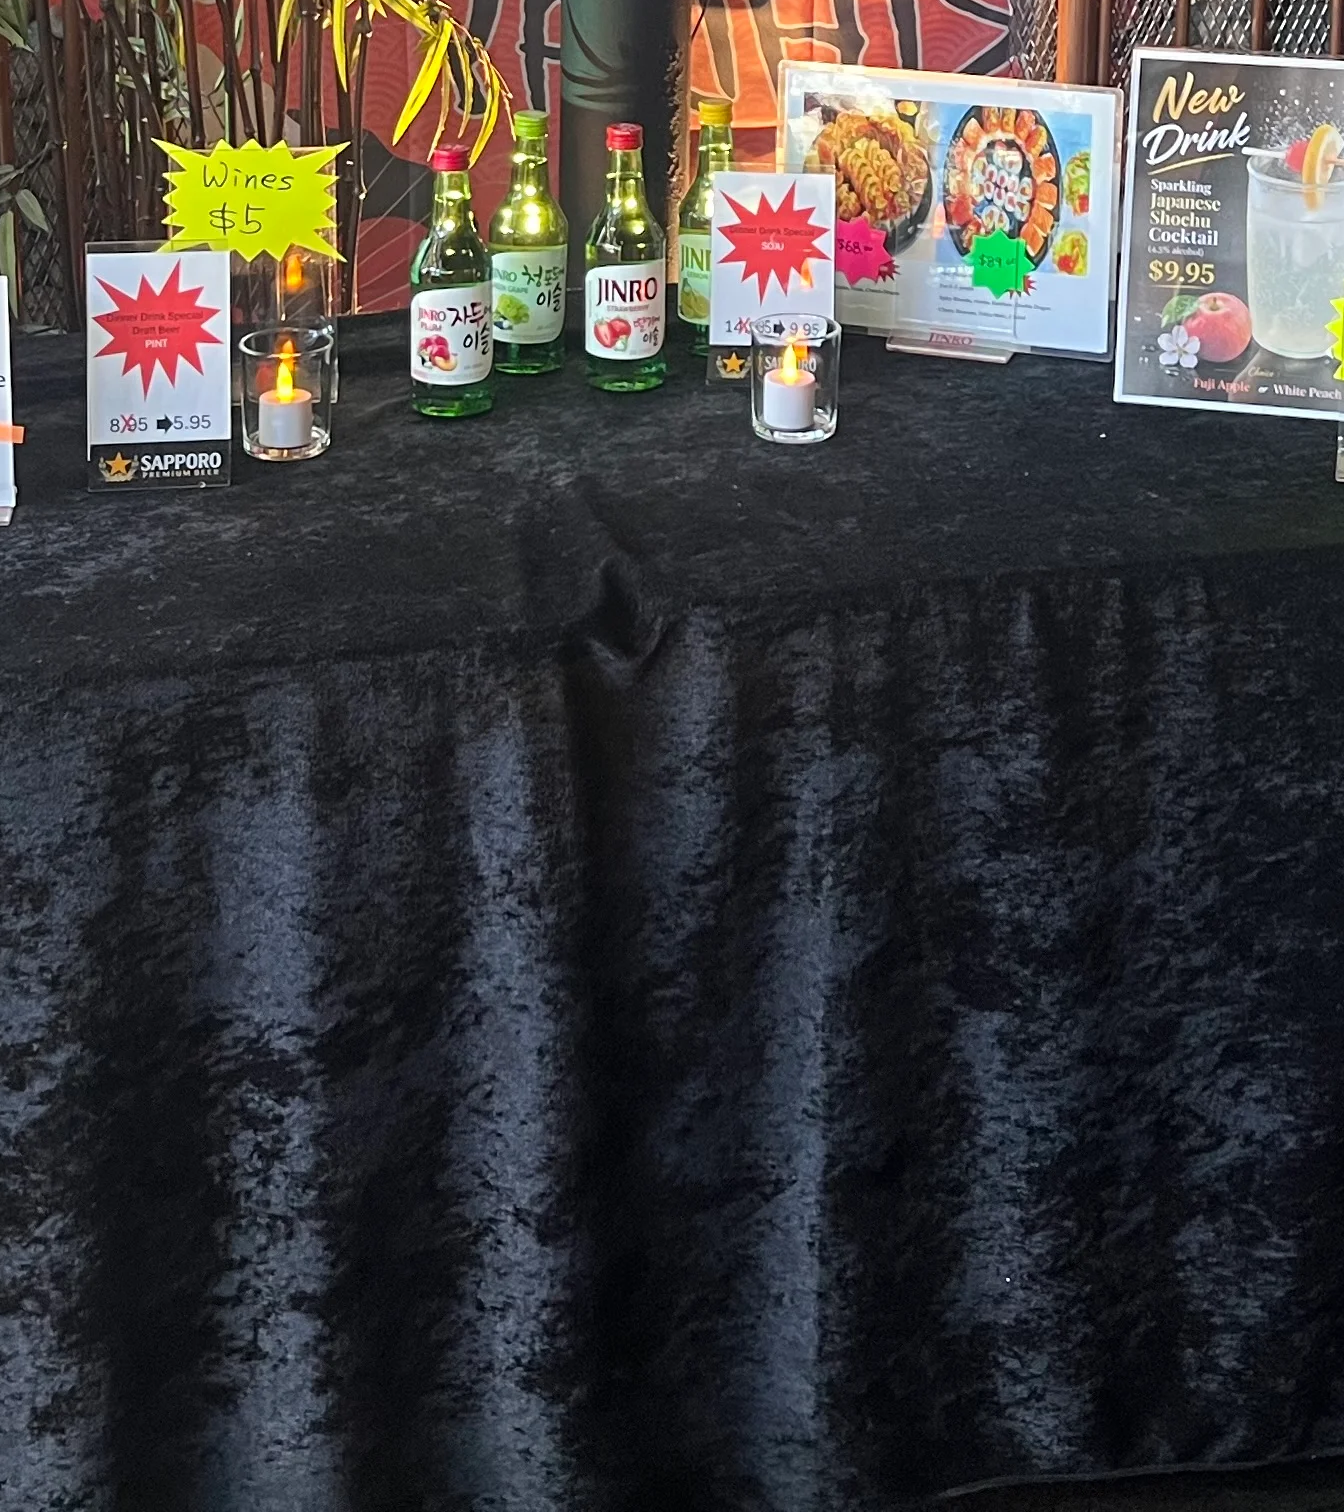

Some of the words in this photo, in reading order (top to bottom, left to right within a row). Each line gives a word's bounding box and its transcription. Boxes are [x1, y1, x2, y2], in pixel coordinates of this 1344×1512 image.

[1152, 71, 1246, 124] New
[1142, 111, 1250, 167] Drink
[203, 160, 295, 191] Wines
[1150, 178, 1212, 196] Sparkling
[1149, 192, 1221, 213] Japanese
[209, 202, 265, 236] $5
[1149, 210, 1211, 229] Shochu
[1148, 227, 1218, 247] Cocktail
[1148, 259, 1215, 285] $9.95
[596, 276, 658, 306] JINRO
[417, 308, 447, 322] JINRO
[145, 338, 169, 348] PINT
[1193, 378, 1215, 392] Fuji
[1217, 379, 1251, 394] Apple
[1273, 384, 1307, 397] White
[1308, 387, 1343, 400] Peach
[173, 414, 212, 430] 5.95
[140, 451, 222, 470] SAPPORO
[142, 469, 191, 478] PREMIUM
